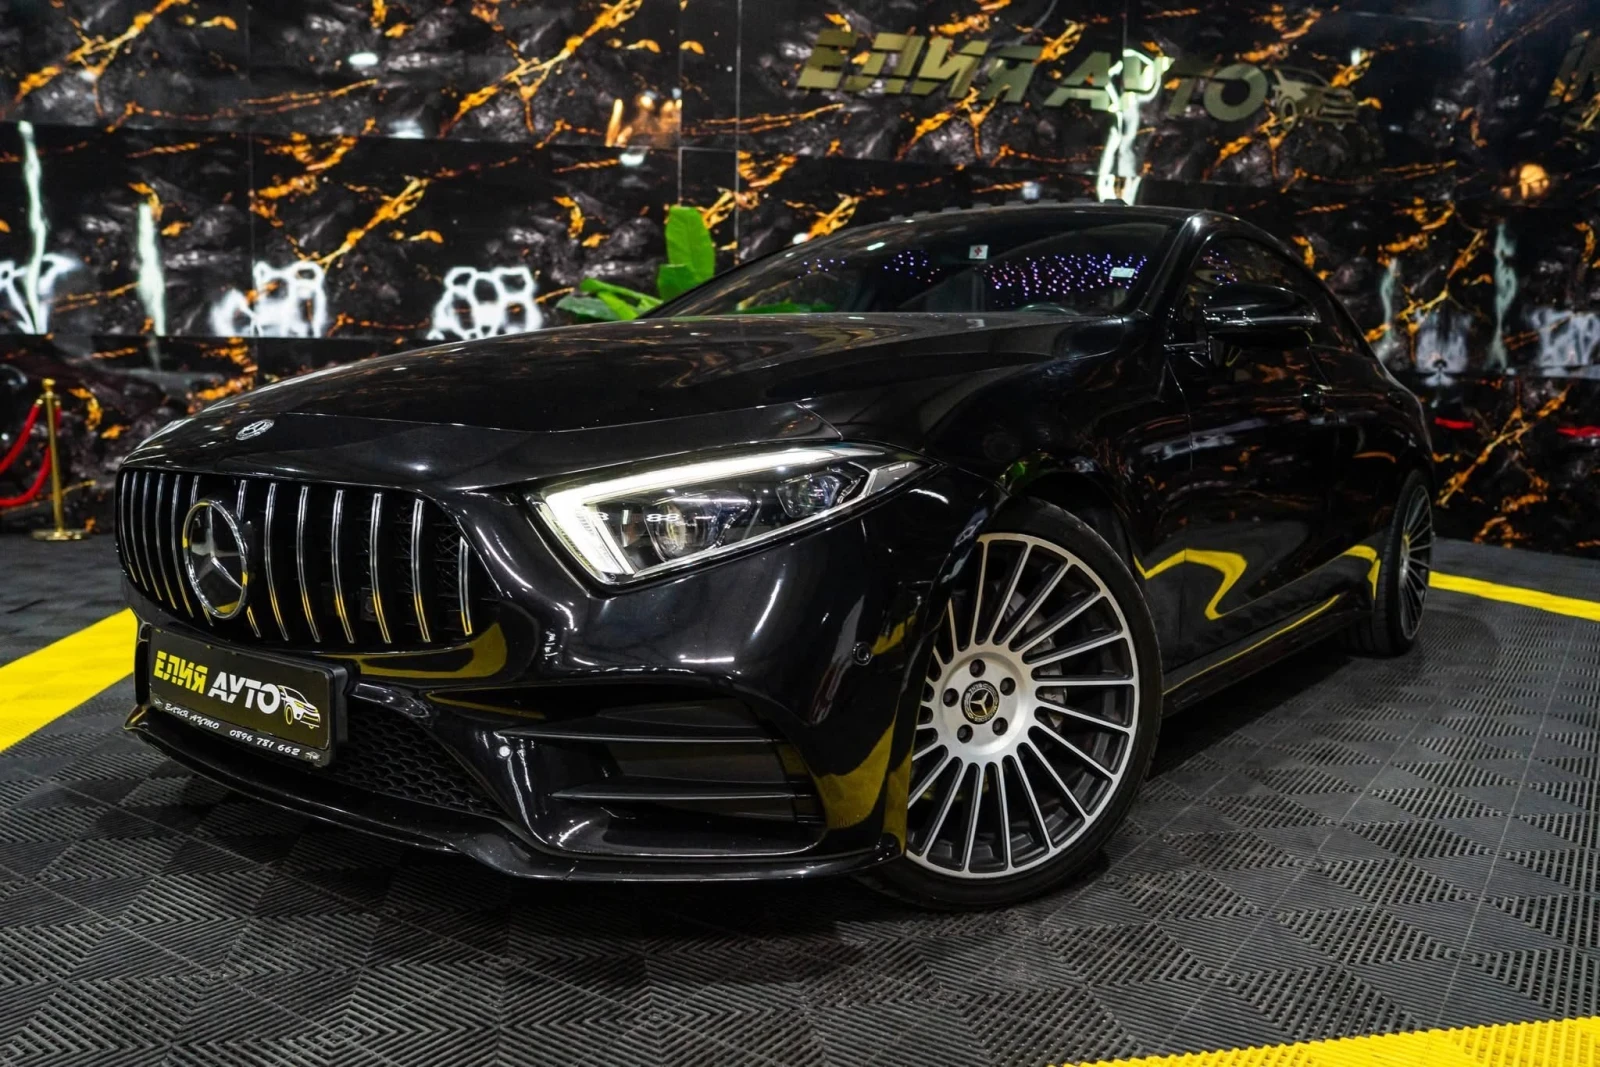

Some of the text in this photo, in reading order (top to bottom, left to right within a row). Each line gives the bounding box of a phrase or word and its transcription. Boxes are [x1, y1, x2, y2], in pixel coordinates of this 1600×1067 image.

[154, 651, 208, 694] ЕЛИЯ
[229, 729, 253, 742] 0896
[256, 737, 275, 749] 781
[277, 743, 301, 756] 662
